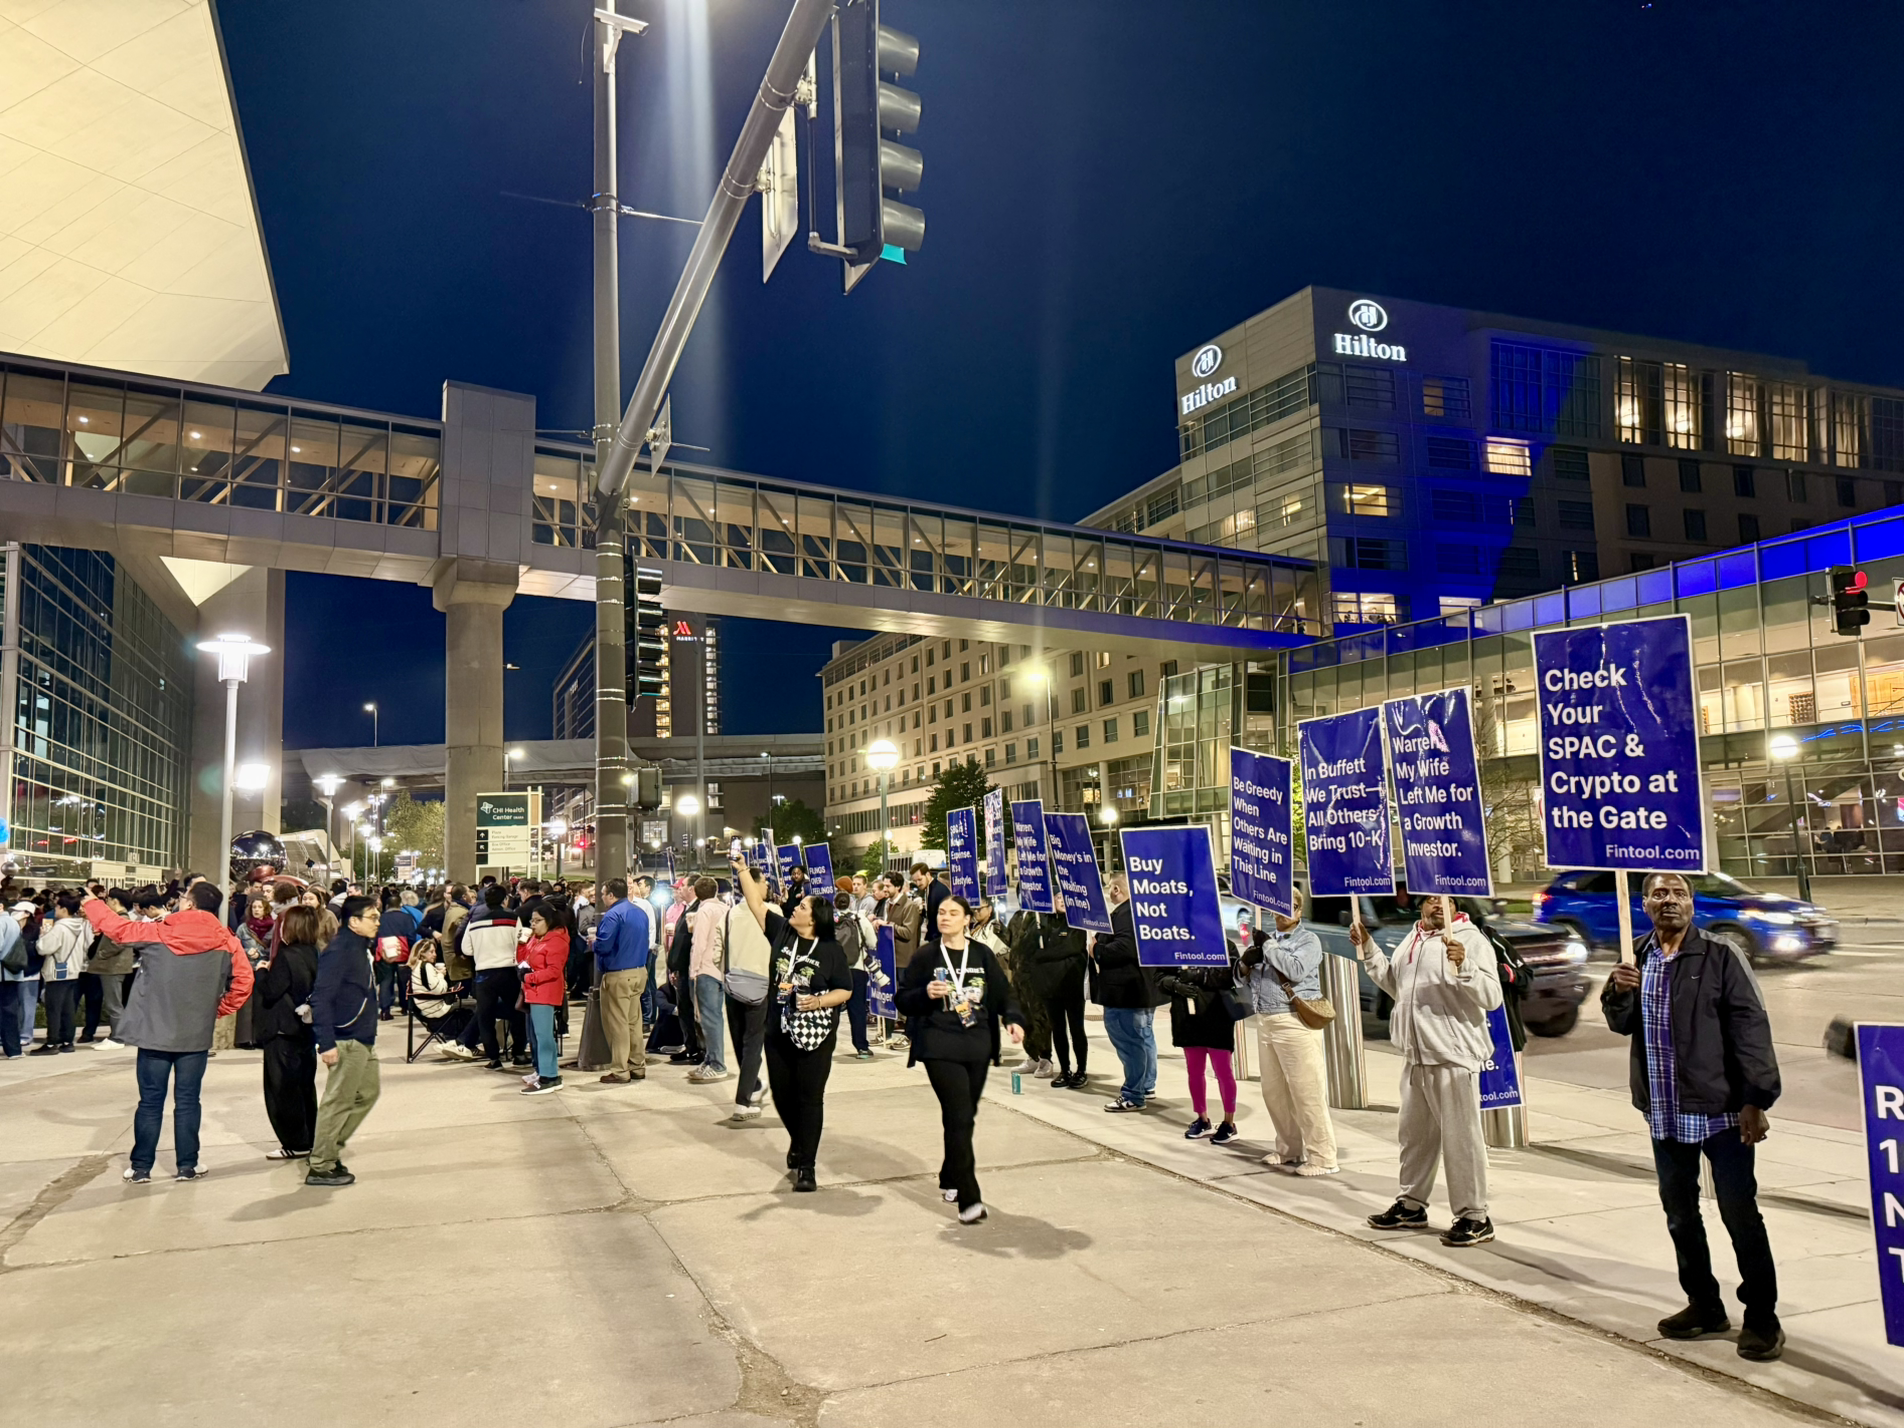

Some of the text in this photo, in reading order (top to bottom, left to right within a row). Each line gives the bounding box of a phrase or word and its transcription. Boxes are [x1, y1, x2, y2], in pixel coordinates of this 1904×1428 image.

[1334, 333, 1407, 361] Hilton
[1181, 376, 1237, 415] Hilton
[1545, 664, 1627, 691] Check
[1547, 703, 1603, 725] Your
[1549, 733, 1645, 759] SPAC &
[1306, 757, 1366, 780] In Buffett
[1396, 759, 1450, 782] My Wife
[1233, 776, 1283, 805] Be Greedy
[1550, 770, 1679, 799] Crypto at
[1307, 787, 1326, 803] We
[1400, 783, 1473, 805] Left Me for
[1233, 796, 1259, 817] When
[1308, 808, 1376, 827] All Others
[1404, 812, 1462, 830] a Growth
[1551, 806, 1667, 829] the Gate
[1234, 816, 1288, 845] Others Are
[1024, 837, 1037, 847] Wife
[1049, 834, 1062, 848] Big
[1309, 834, 1346, 853] Bring
[1407, 839, 1462, 857] Investor.
[1037, 851, 1046, 861] for
[1053, 849, 1092, 864] Money's in
[1234, 836, 1282, 865] Waiting in
[1605, 844, 1700, 859] Fintool.com
[1023, 866, 1043, 876] Growth
[1058, 865, 1069, 876] the
[1129, 856, 1163, 875] Buy
[1233, 855, 1277, 884] This Line
[952, 876, 974, 887] Lifestyle.
[1061, 879, 1088, 895] Waiting
[1132, 879, 1194, 897] Moats,
[1344, 876, 1391, 887] Fintool.com
[1435, 874, 1486, 887] Fintool.com
[1065, 894, 1090, 911] (in line)
[1135, 902, 1167, 917] Not
[1253, 890, 1290, 911] Fintool.com
[1083, 917, 1110, 928] Fintool.com
[1139, 924, 1196, 940] Boats.
[1174, 952, 1226, 960] Fintool.com
